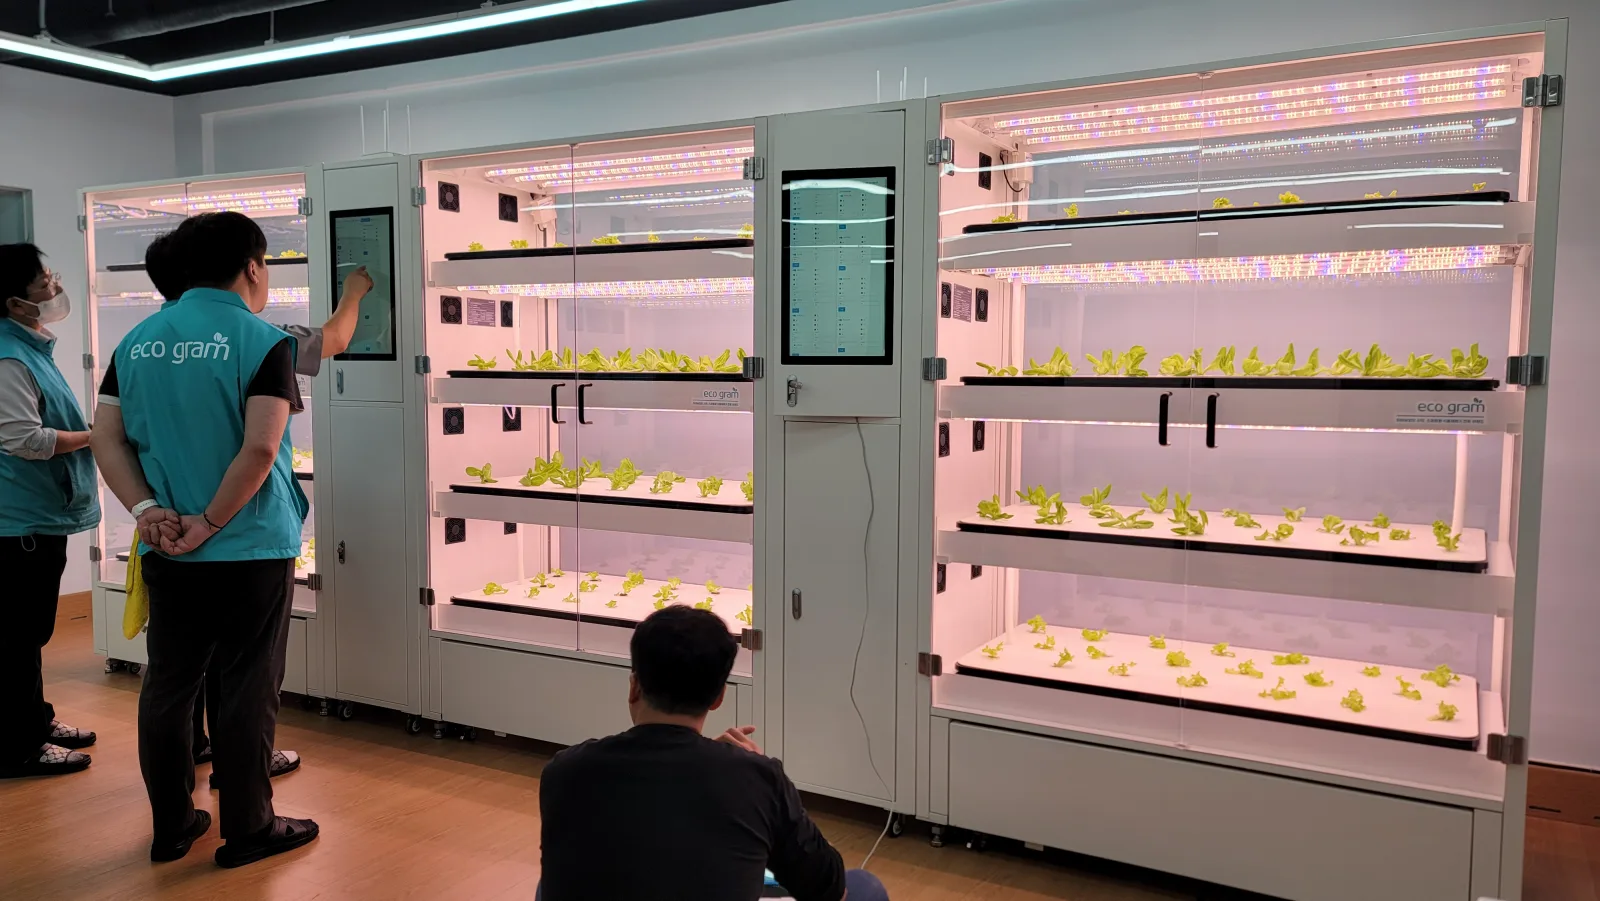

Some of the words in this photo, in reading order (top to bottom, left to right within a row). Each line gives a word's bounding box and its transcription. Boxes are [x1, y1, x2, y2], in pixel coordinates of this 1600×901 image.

[130, 340, 166, 360] eco
[171, 339, 230, 364] gram
[703, 390, 718, 398] eco
[719, 390, 739, 399] gram
[1417, 402, 1443, 412] eco
[1447, 402, 1485, 415] gram
